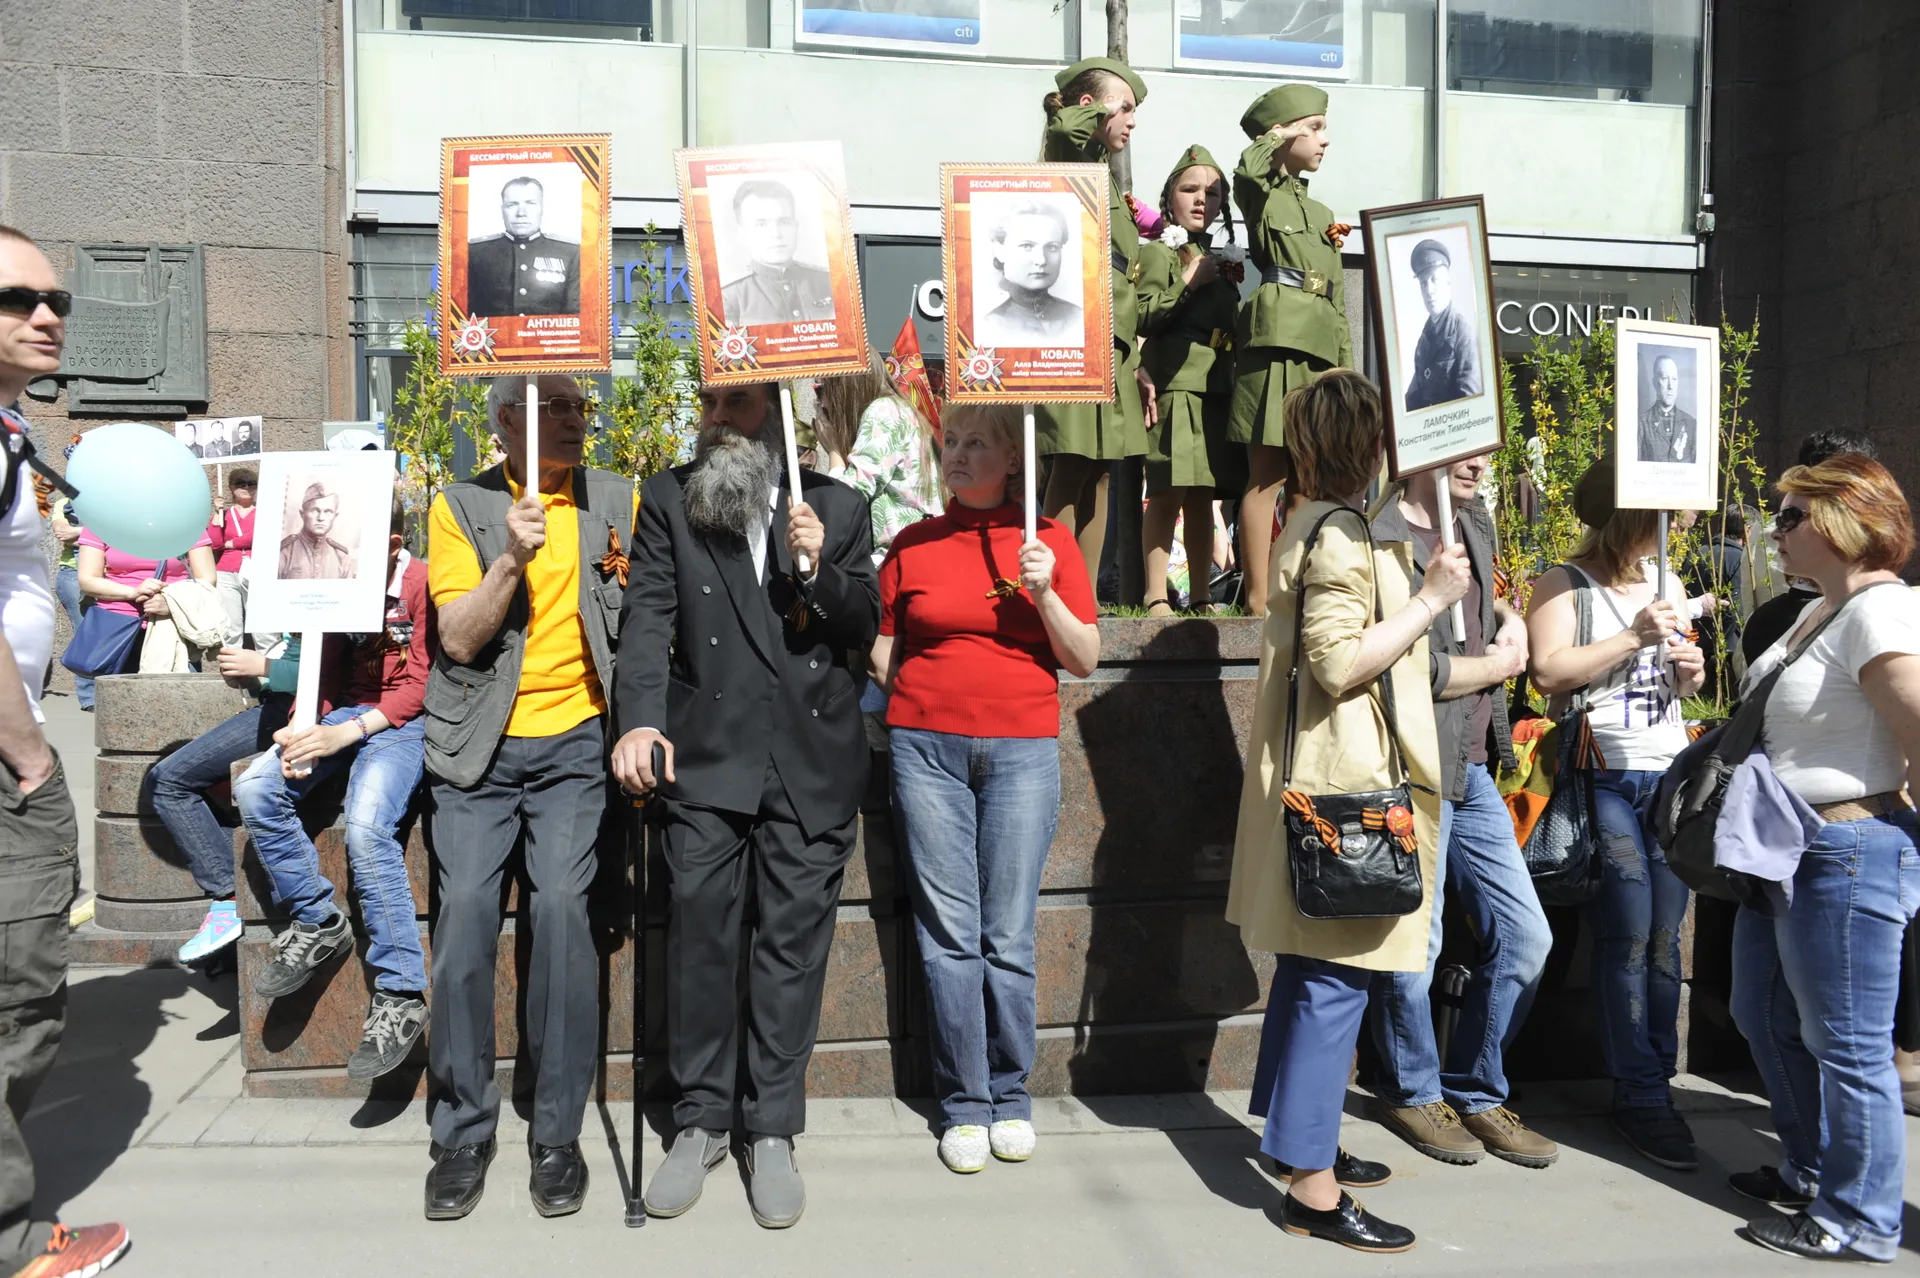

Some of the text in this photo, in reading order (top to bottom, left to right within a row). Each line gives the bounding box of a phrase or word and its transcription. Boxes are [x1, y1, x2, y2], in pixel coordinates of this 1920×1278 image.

[954, 26, 973, 38] citi
[1320, 52, 1338, 62] citi
[470, 152, 552, 162] БЕССМЕРТНЫЙ ПОЛК
[970, 180, 1028, 188] БЕССМЕРТНЫЙ
[527, 318, 580, 328] АНТУШЕВ
[793, 322, 836, 334] КОВАЛЬ
[766, 337, 798, 345] Валентин
[75, 346, 157, 356] ВАСИЛЬЕВИЧ
[1041, 350, 1084, 360] КОВАЛЬ
[68, 357, 158, 368] ВАСИЛЬЕВ
[1423, 408, 1469, 429] ЛАМОЧКИН
[1398, 415, 1494, 448] Константин Тимофеевич
